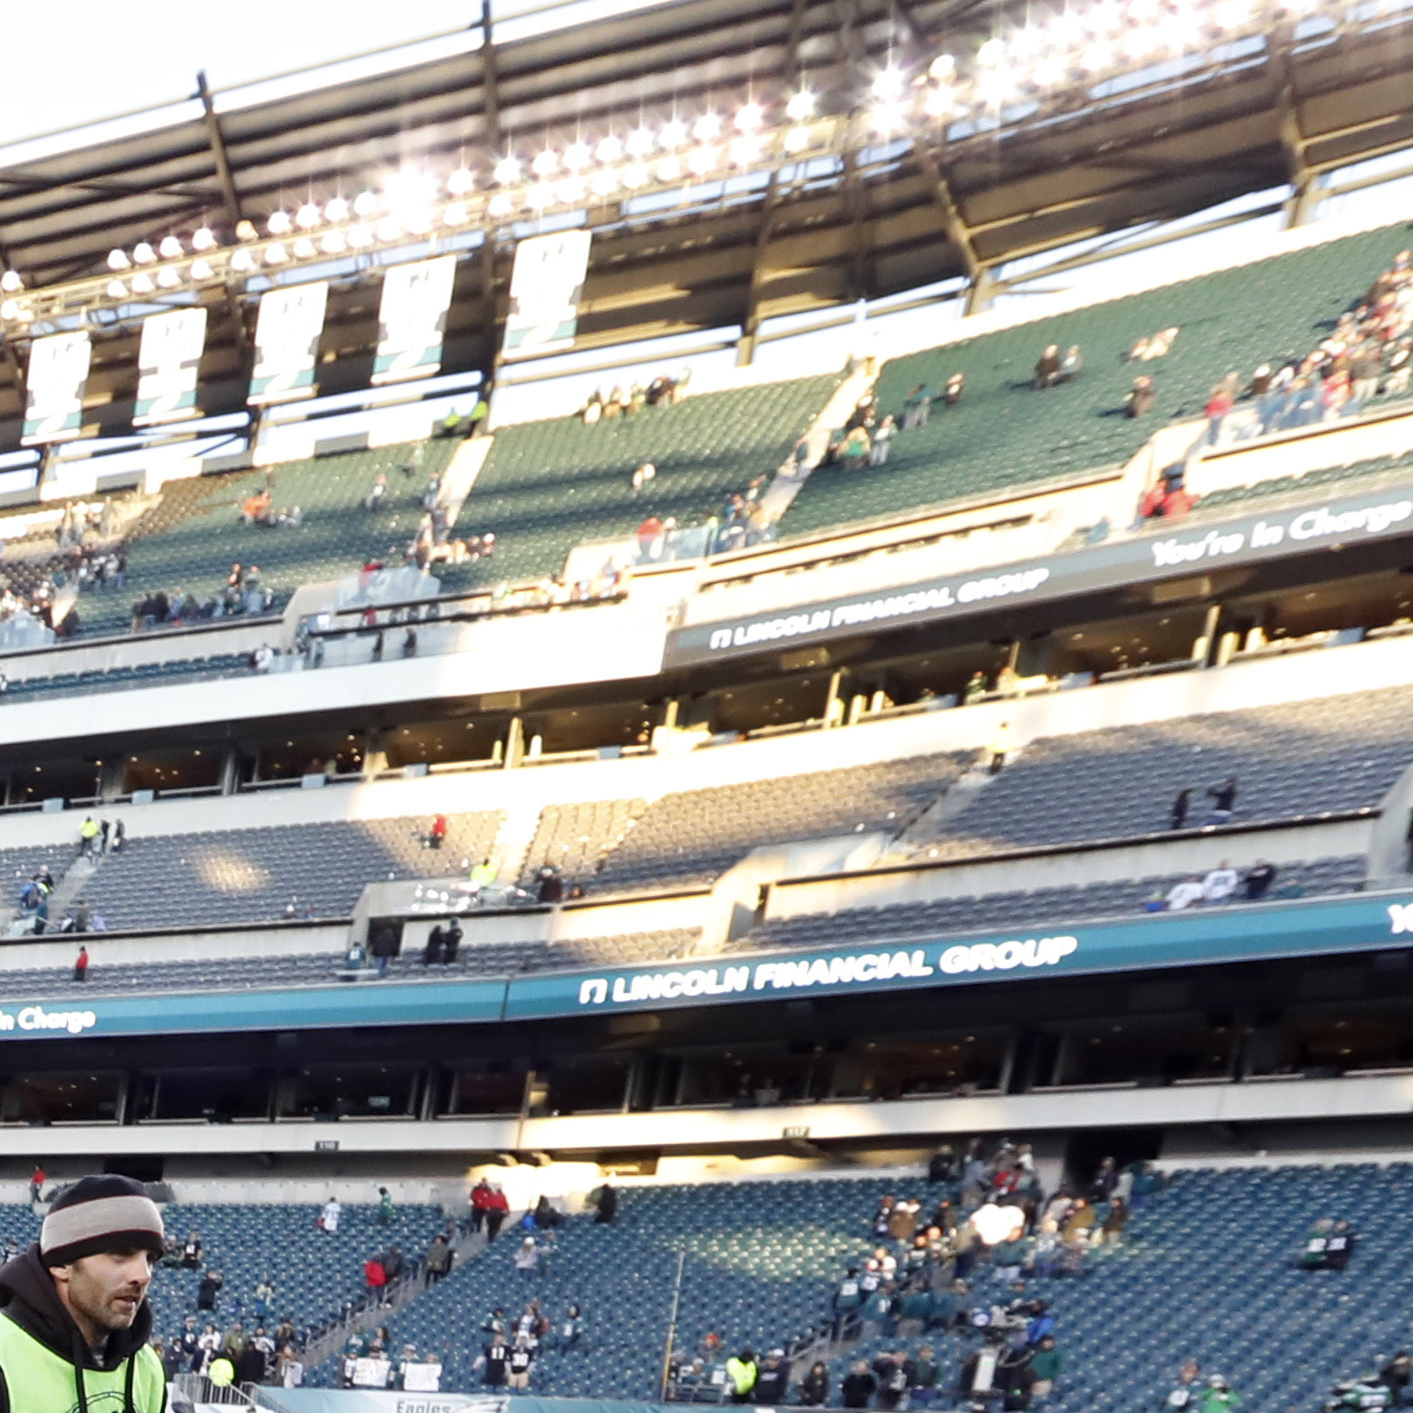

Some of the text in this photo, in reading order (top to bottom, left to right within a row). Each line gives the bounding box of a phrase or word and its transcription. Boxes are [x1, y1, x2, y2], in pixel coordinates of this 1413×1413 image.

[1152, 500, 1413, 567] You're In Charge
[734, 568, 1050, 646] LINCOLN FINANCIAL GROUP
[612, 935, 1078, 1002] LINCOLN FINANCIAL GROUP
[17, 1006, 97, 1034] Charge
